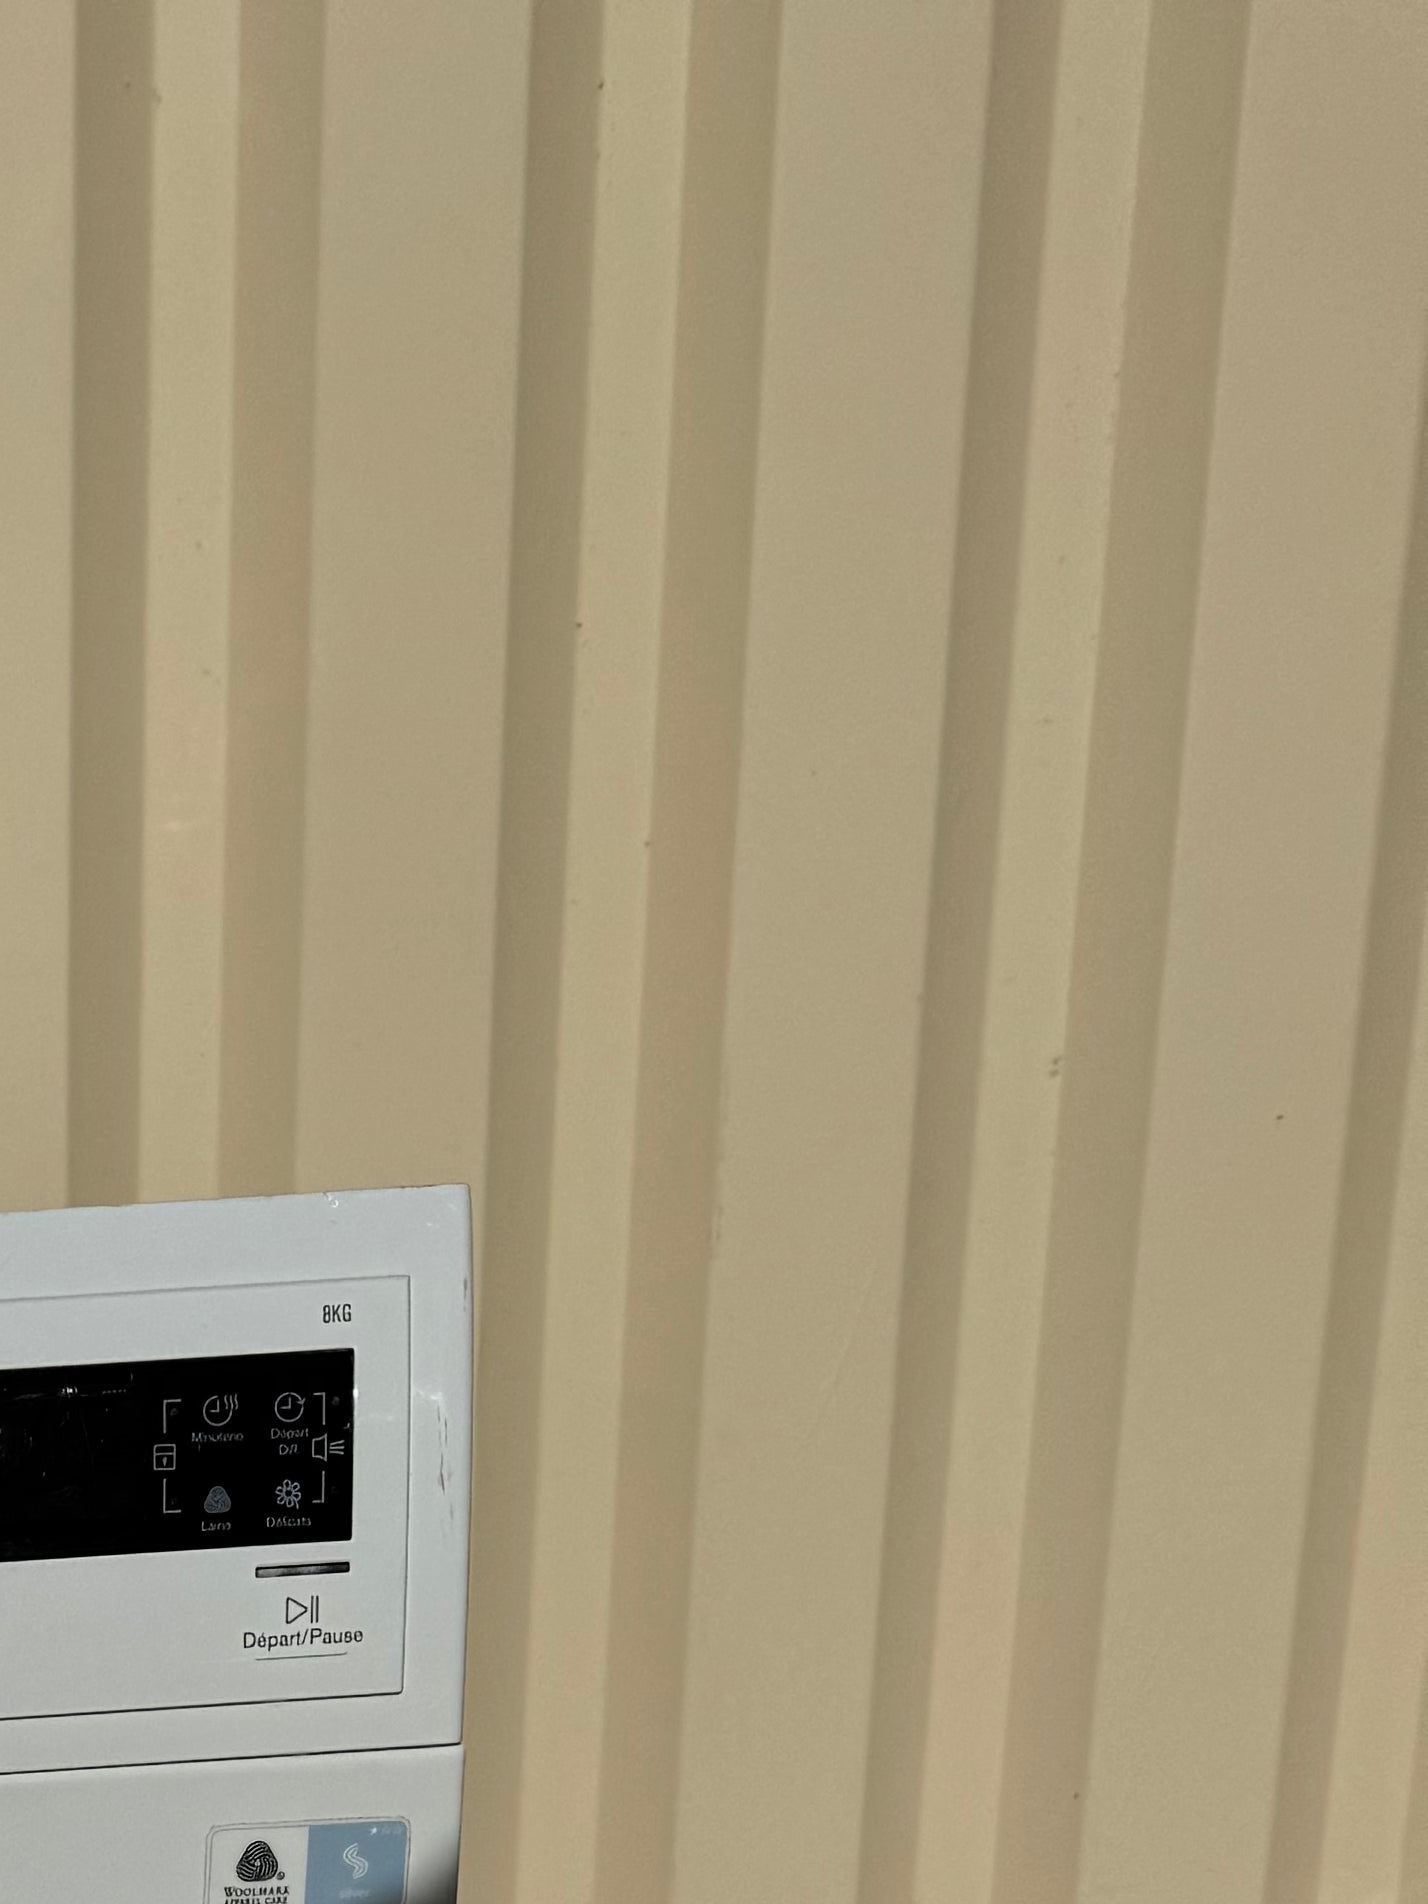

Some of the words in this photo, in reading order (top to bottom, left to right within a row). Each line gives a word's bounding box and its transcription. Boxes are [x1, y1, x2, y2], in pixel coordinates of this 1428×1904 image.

[322, 1303, 352, 1324] 8KG
[243, 1627, 364, 1651] Départ/Pause
[223, 1884, 290, 1899] WOOLMARK
